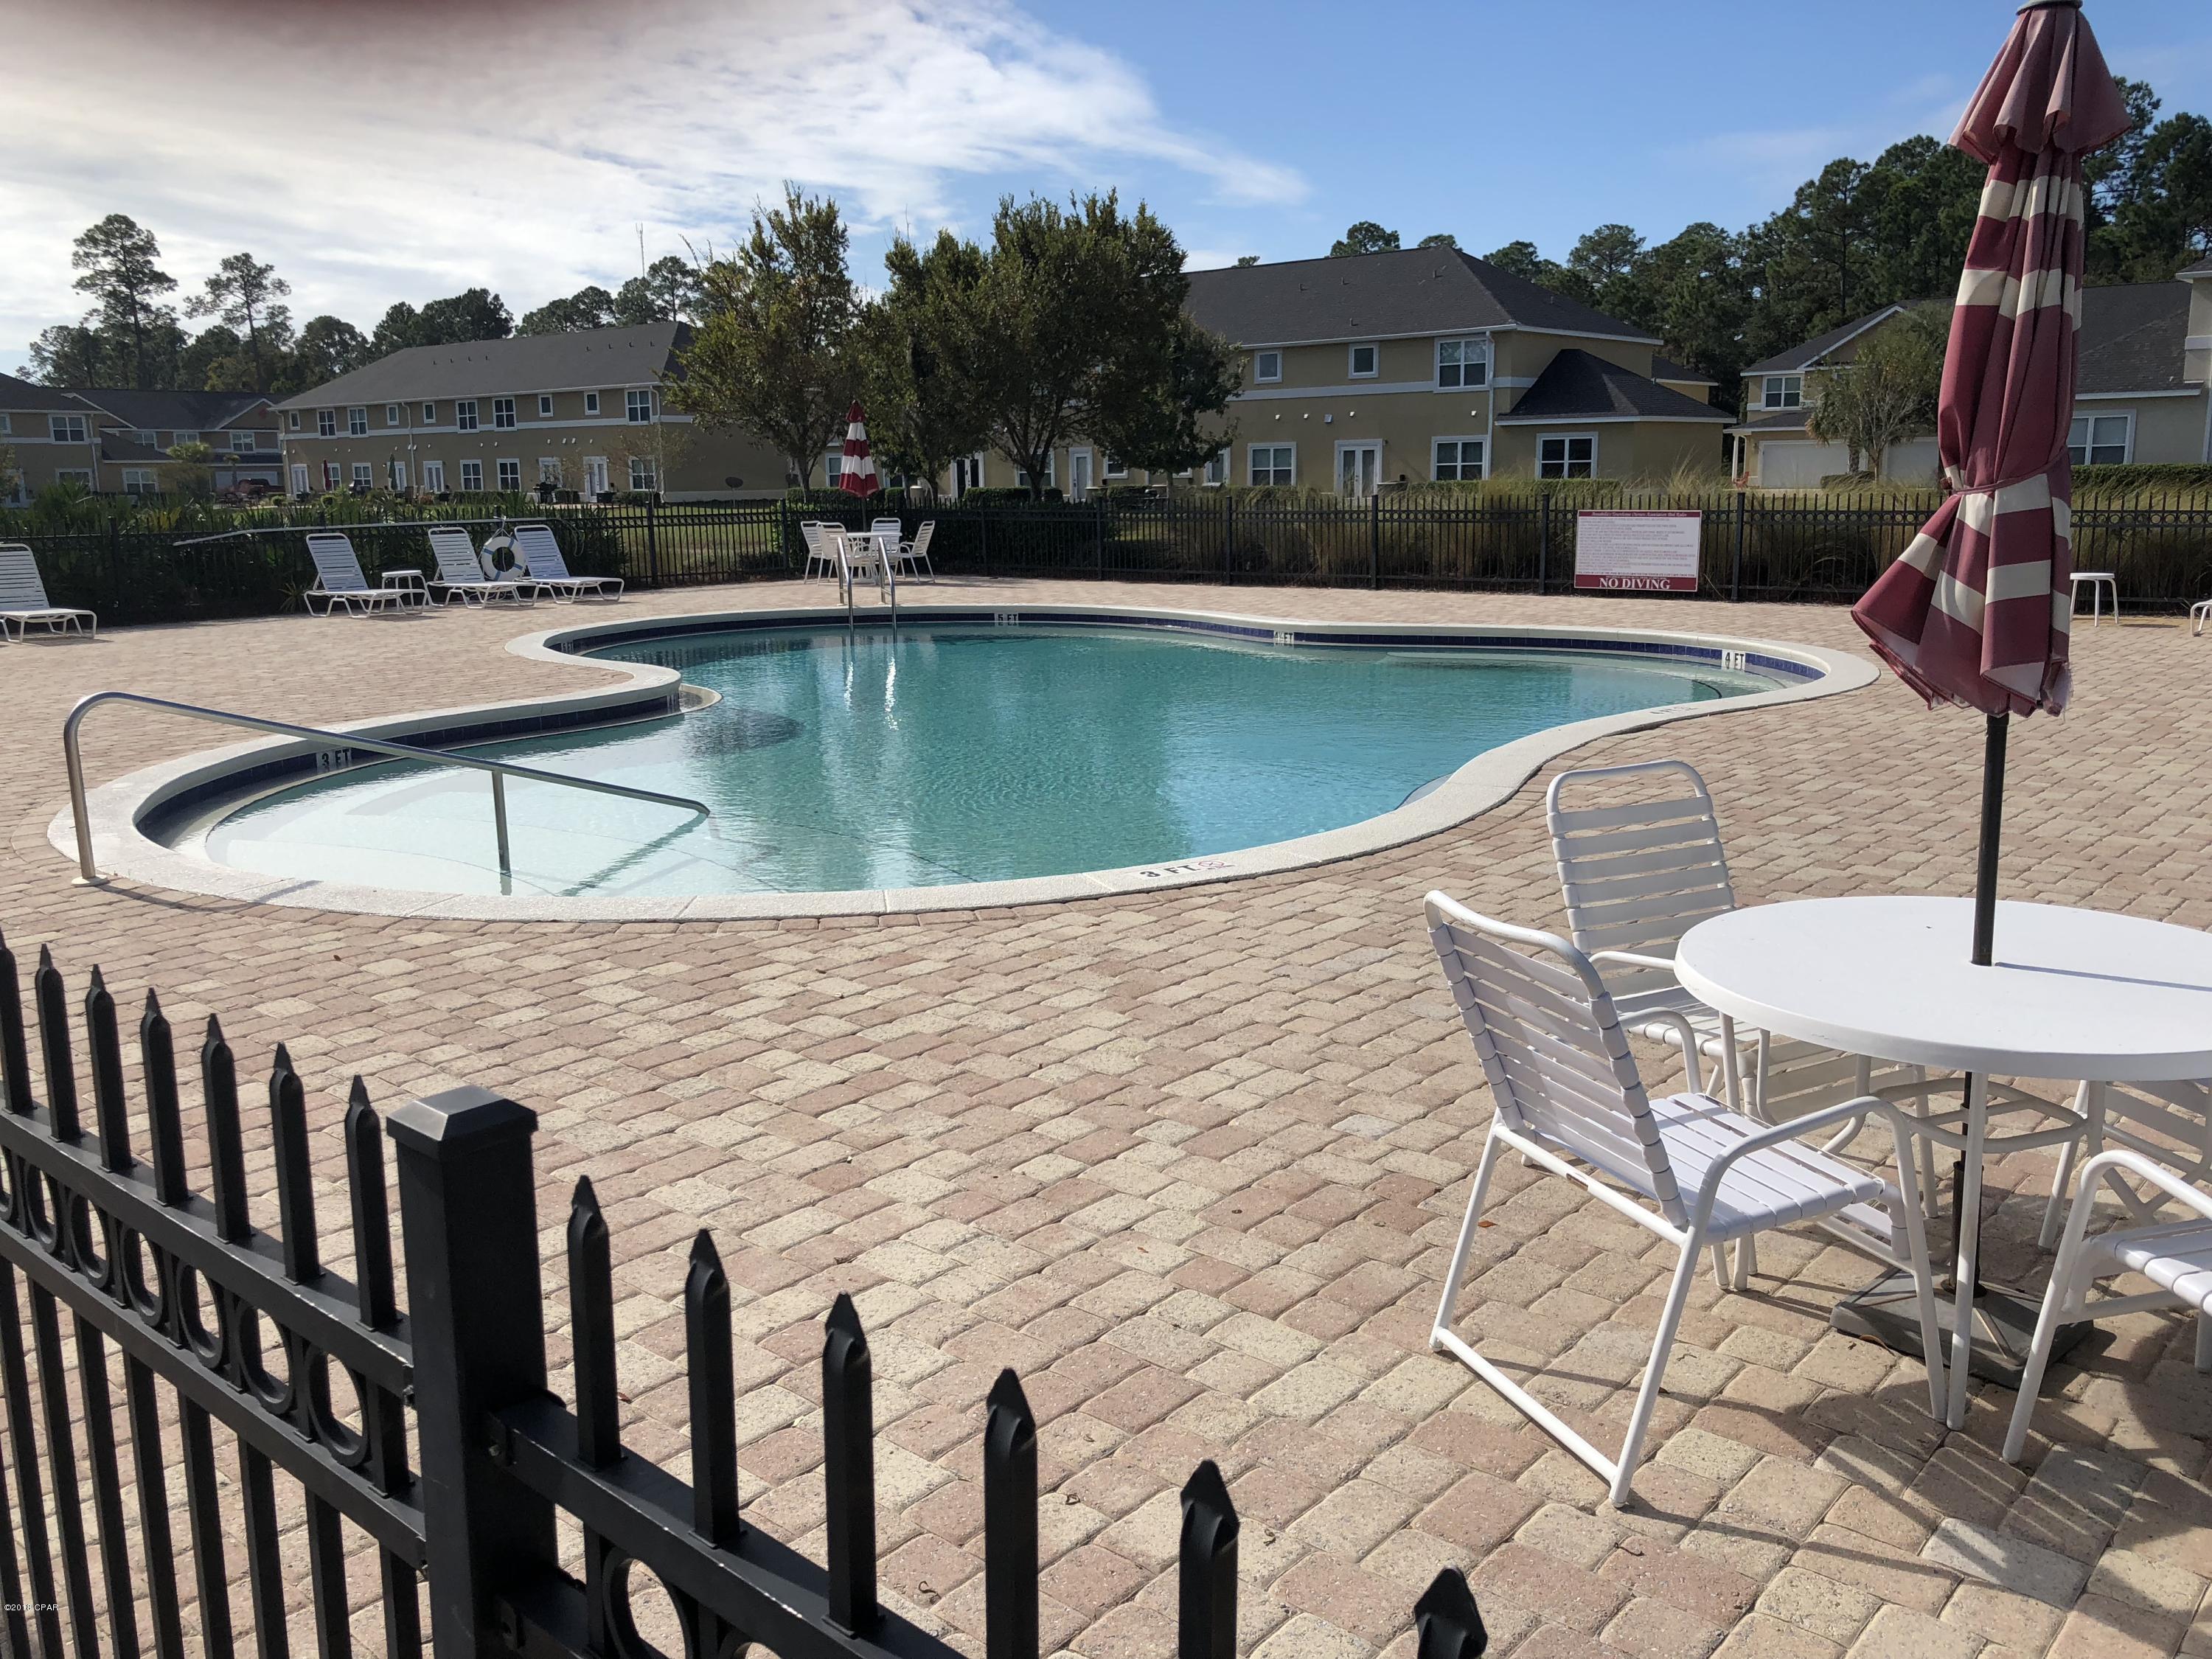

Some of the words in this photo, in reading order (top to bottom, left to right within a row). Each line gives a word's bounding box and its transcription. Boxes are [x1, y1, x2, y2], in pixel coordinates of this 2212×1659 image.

[1599, 577, 1618, 588] NO
[1622, 578, 1670, 590] DIVING
[1725, 652, 1731, 664] 4
[1734, 653, 1745, 665] FT
[321, 752, 330, 766] 3
[335, 748, 349, 766] FT
[1164, 865, 1200, 874] FT
